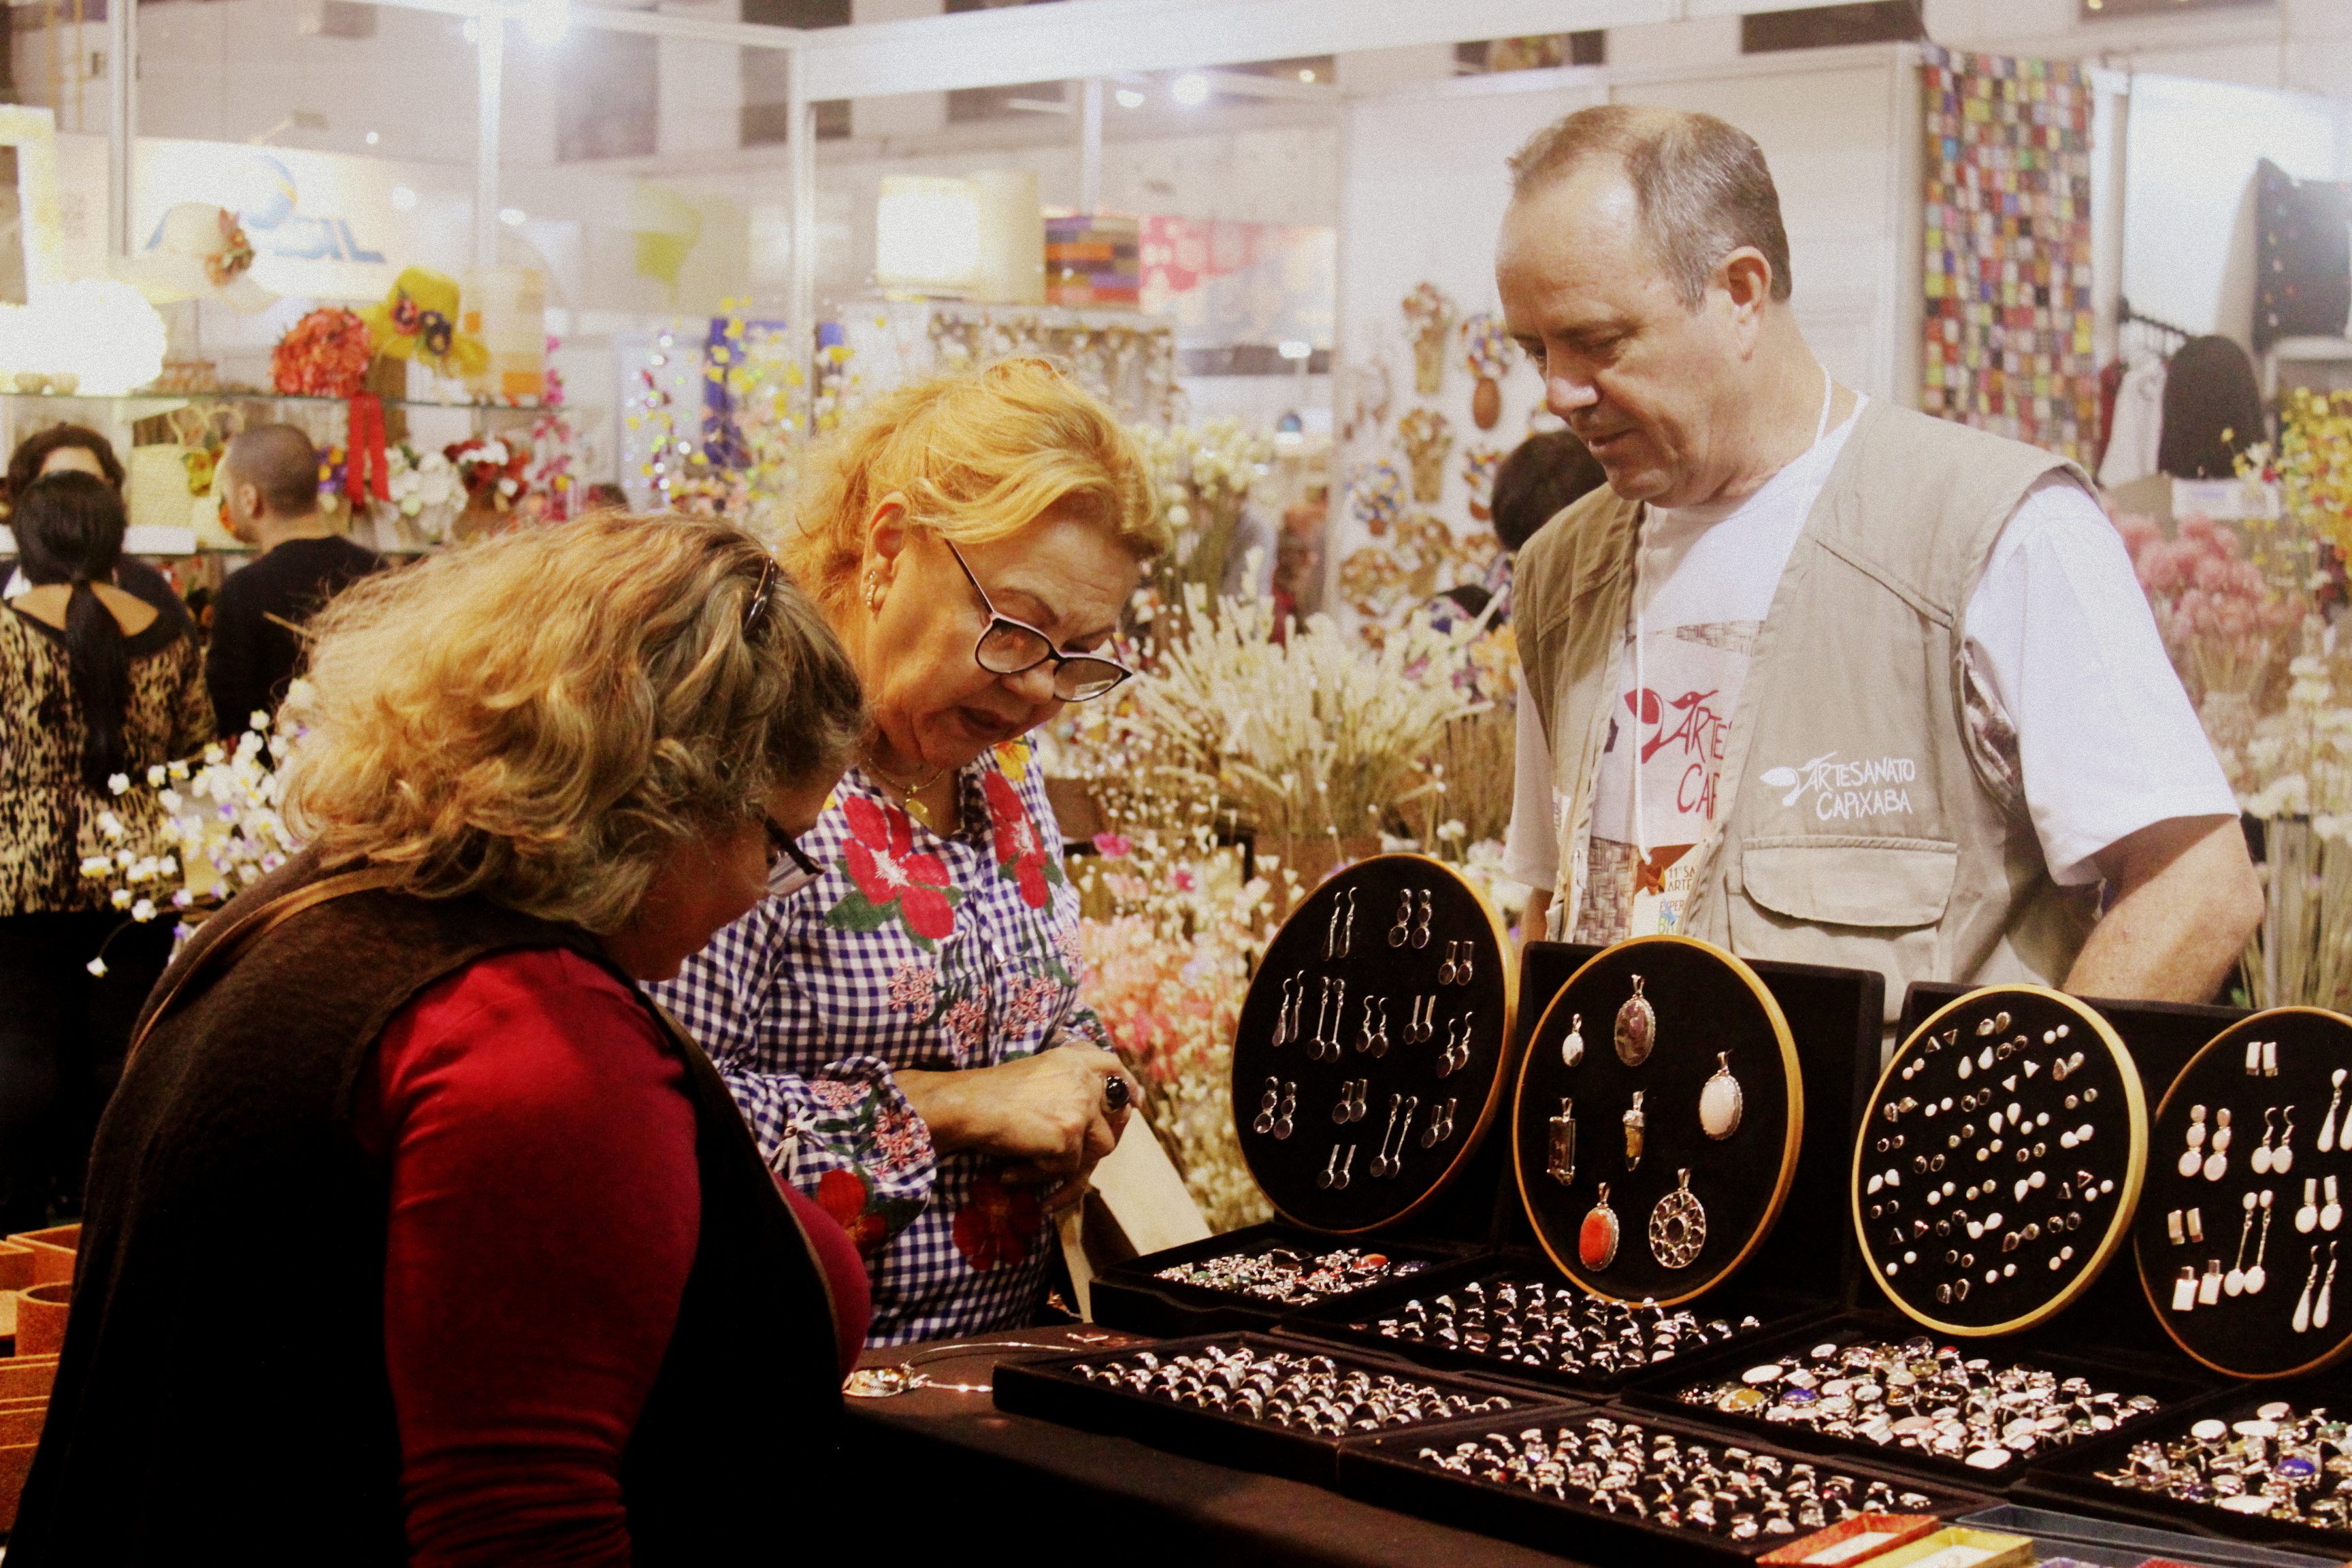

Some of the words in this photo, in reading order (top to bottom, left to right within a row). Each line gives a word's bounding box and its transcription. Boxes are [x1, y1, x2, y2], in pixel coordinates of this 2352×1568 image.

[1667, 690, 1732, 764] ARTE
[1801, 753, 1916, 792] ARTESANATO
[1816, 789, 1913, 821] CAPIXABA
